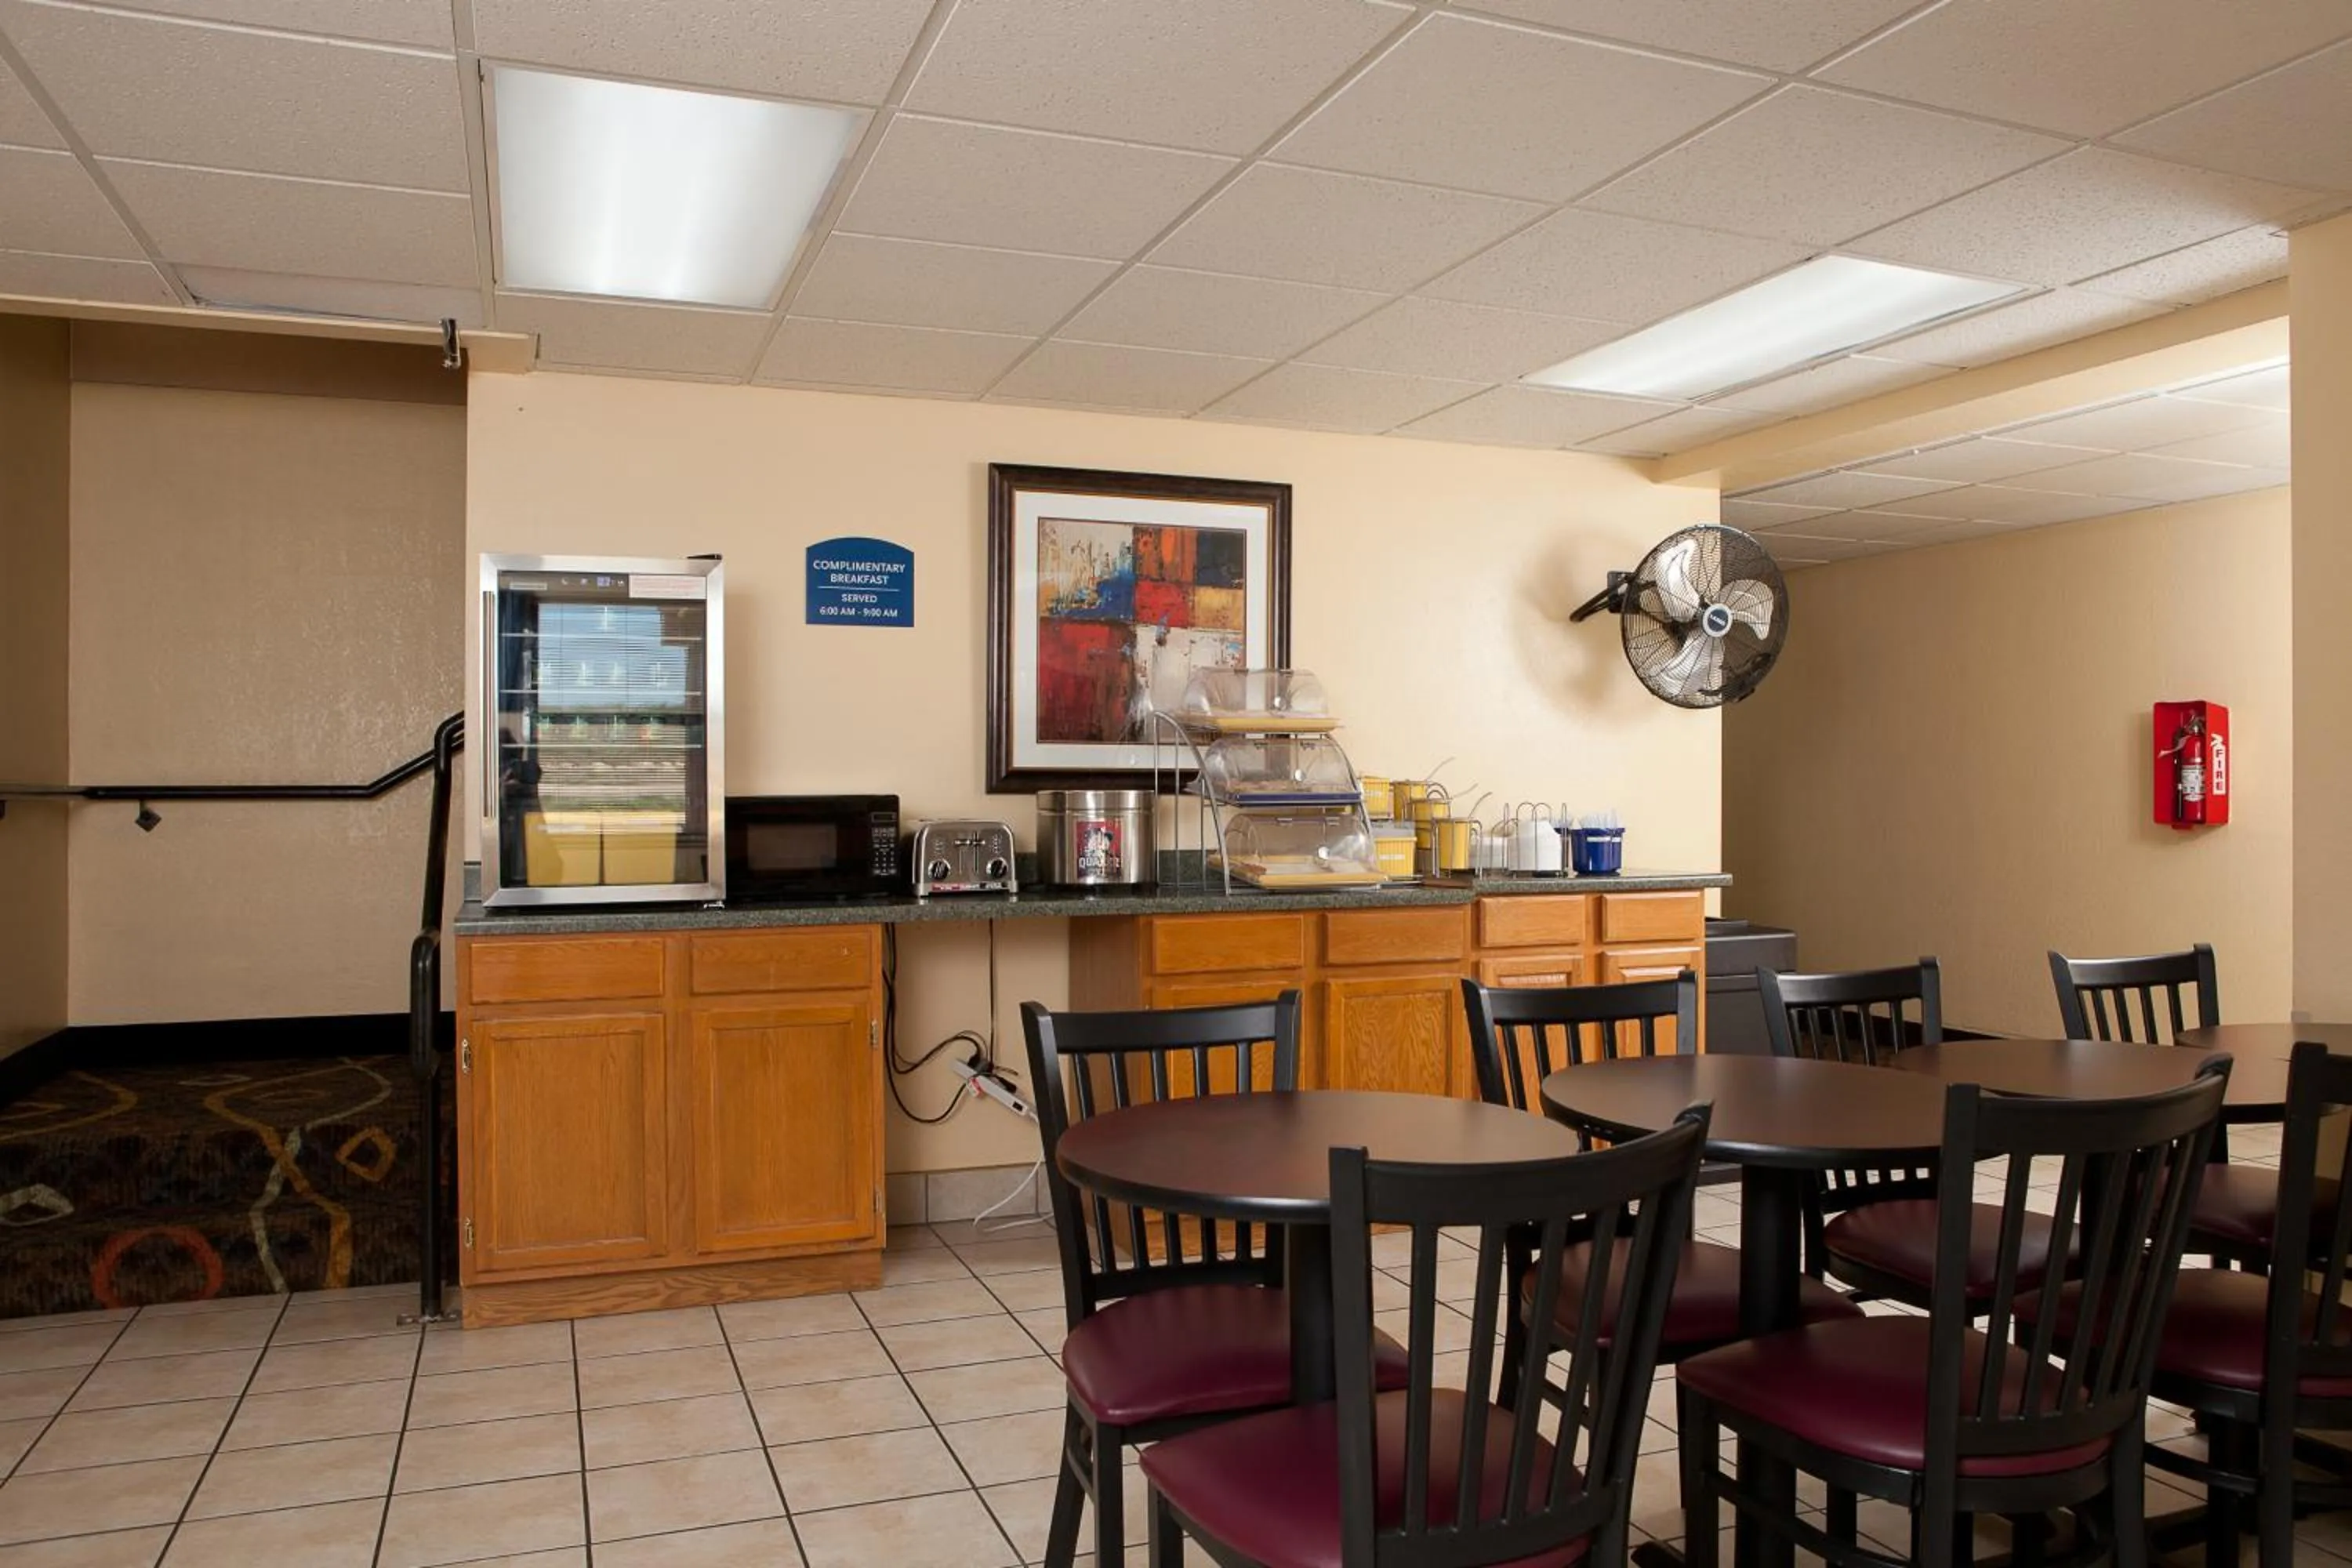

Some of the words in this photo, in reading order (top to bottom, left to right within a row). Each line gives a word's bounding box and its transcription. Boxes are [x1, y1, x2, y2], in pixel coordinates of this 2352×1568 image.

[813, 561, 906, 573] COMPLIMENTARY
[830, 574, 890, 585] BREAKFAST
[841, 593, 878, 603] SERVED
[819, 606, 838, 615] 6:00
[840, 607, 855, 615] AM
[863, 608, 882, 617] 9:00
[883, 608, 898, 617] AM
[2215, 749, 2224, 791] FIRE
